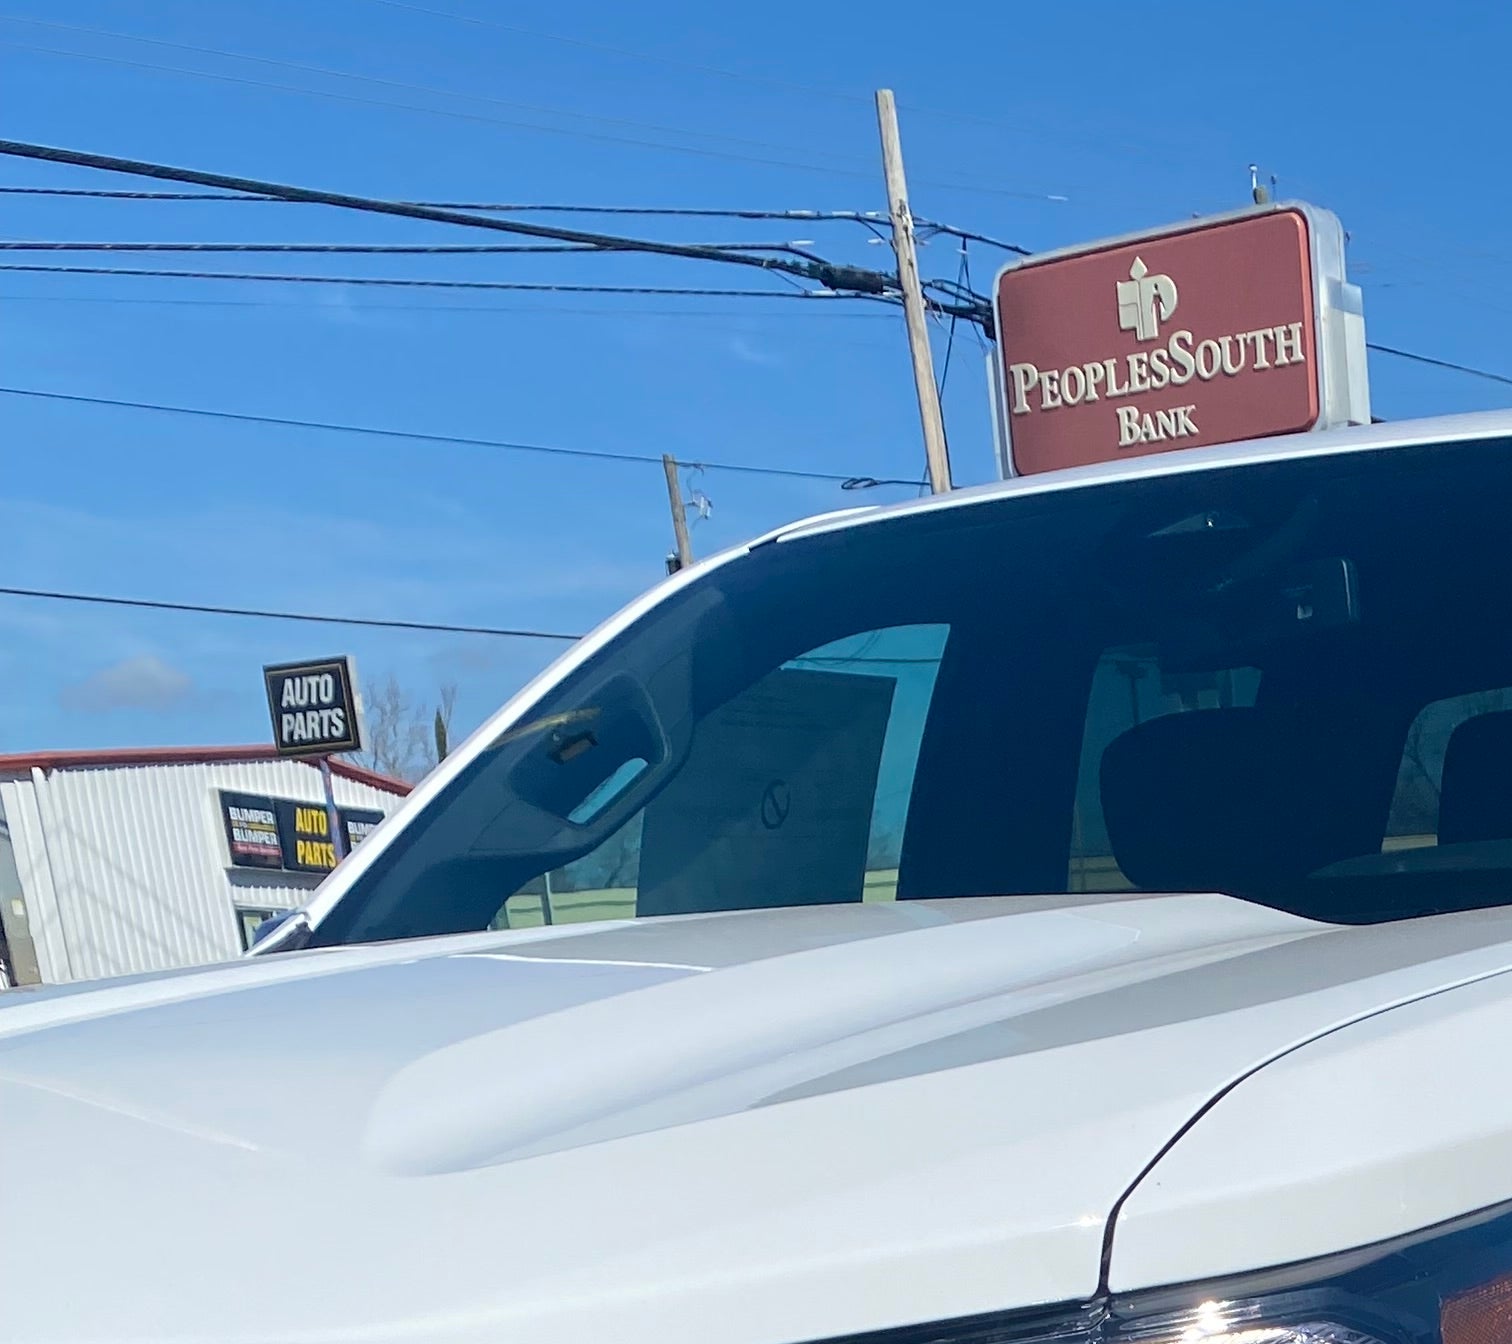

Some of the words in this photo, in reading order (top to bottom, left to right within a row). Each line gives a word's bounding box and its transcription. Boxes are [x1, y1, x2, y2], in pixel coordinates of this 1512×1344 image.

[1116, 404, 1200, 447] BANK
[281, 672, 334, 708] AUTO
[282, 707, 345, 743] PARTS
[228, 806, 275, 825] BUMPER
[295, 807, 328, 836] AUTO
[232, 827, 278, 846] BUMPER
[296, 840, 338, 869] PARTS
